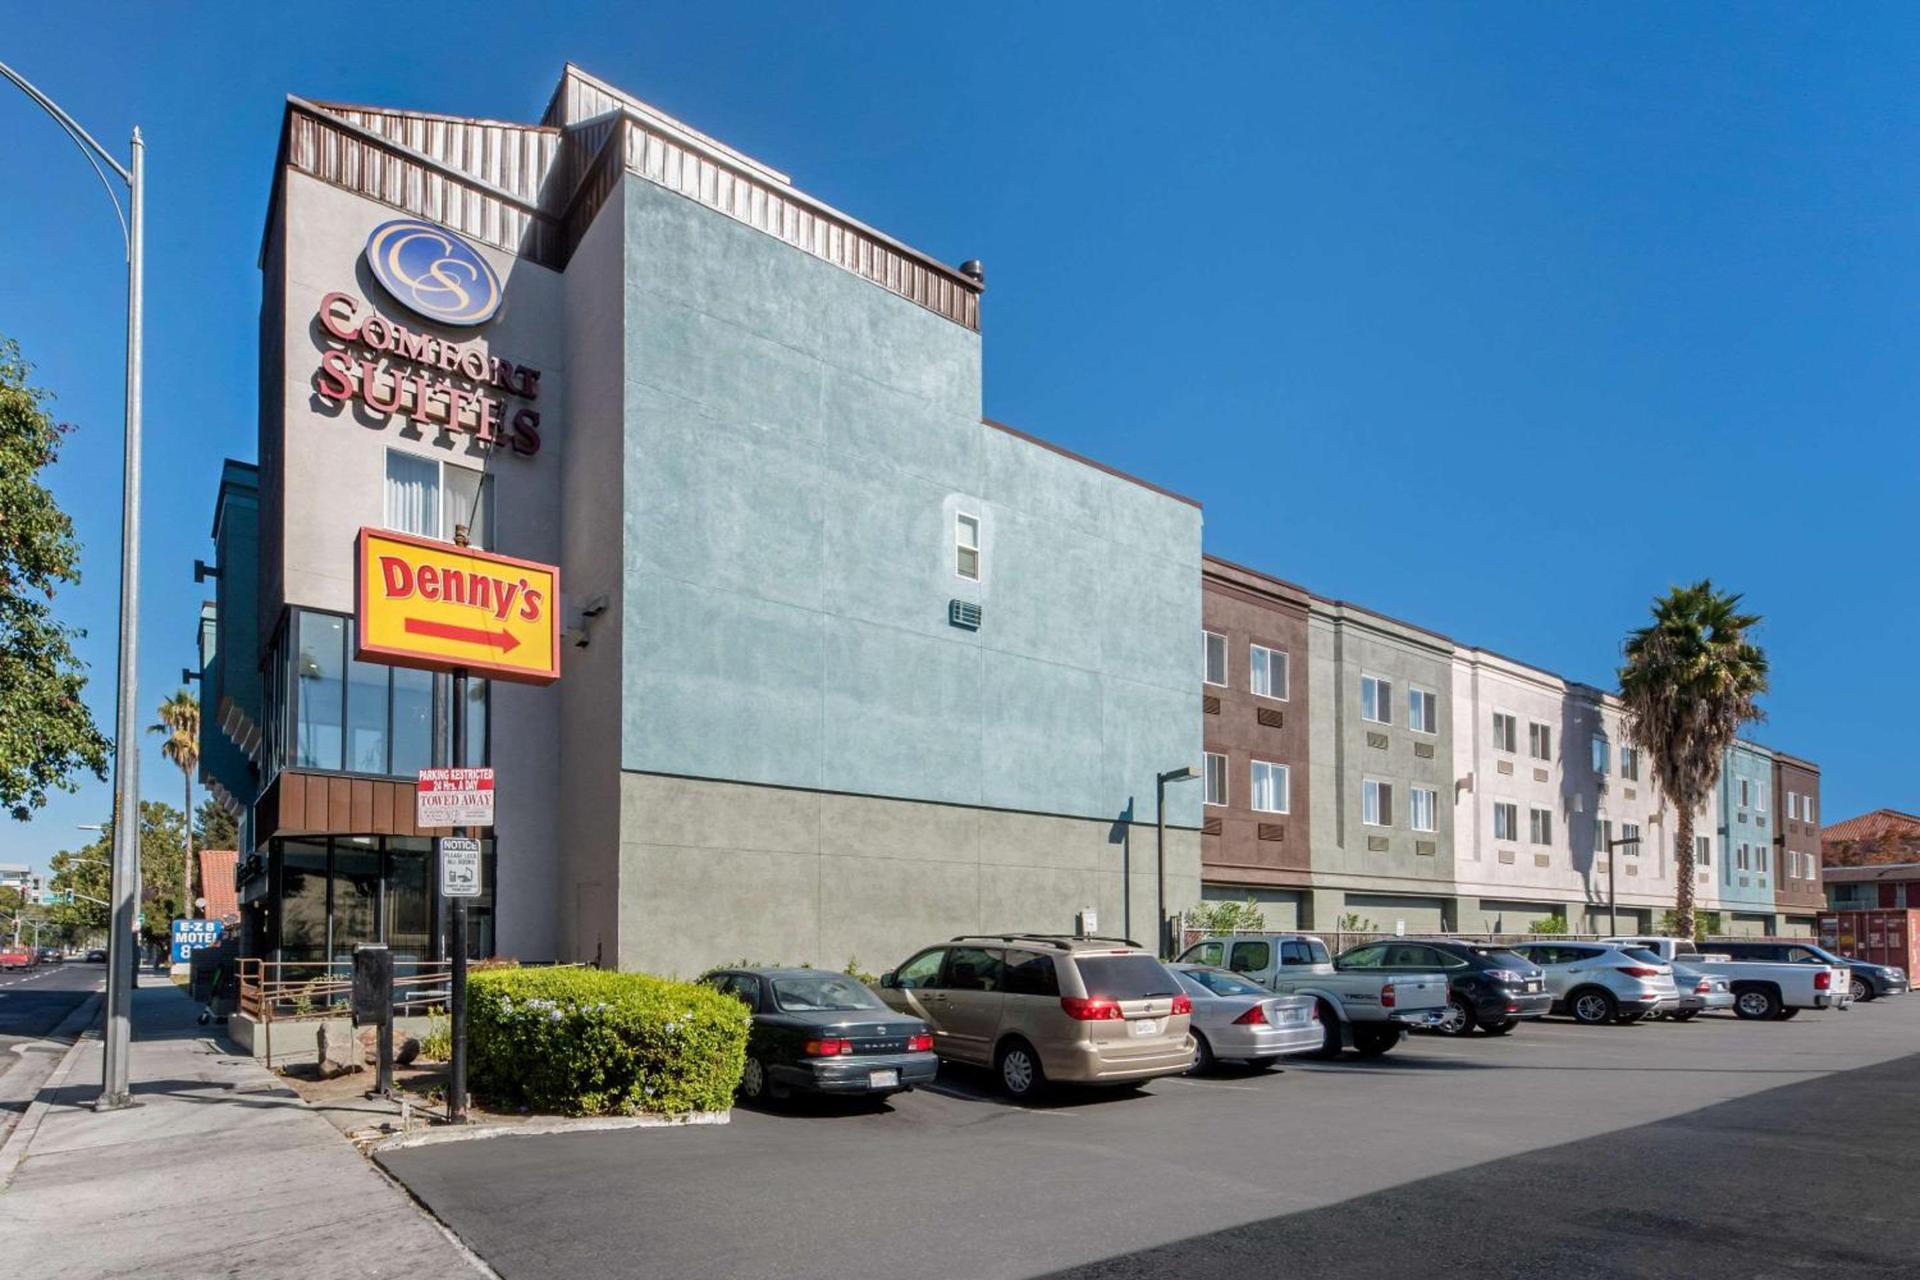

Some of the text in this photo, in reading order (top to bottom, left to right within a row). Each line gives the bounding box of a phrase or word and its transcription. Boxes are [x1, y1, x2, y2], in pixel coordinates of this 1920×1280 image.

[320, 292, 540, 399] COMFORT
[319, 351, 541, 455] SUITES
[379, 556, 543, 622] Denny's
[420, 768, 494, 781] PARKING RESTRICTED
[465, 780, 478, 791] DAY
[421, 794, 492, 807] TOWED AWAY
[444, 840, 477, 850] NOTICE
[206, 922, 215, 932] 8
[180, 944, 204, 959] 8
